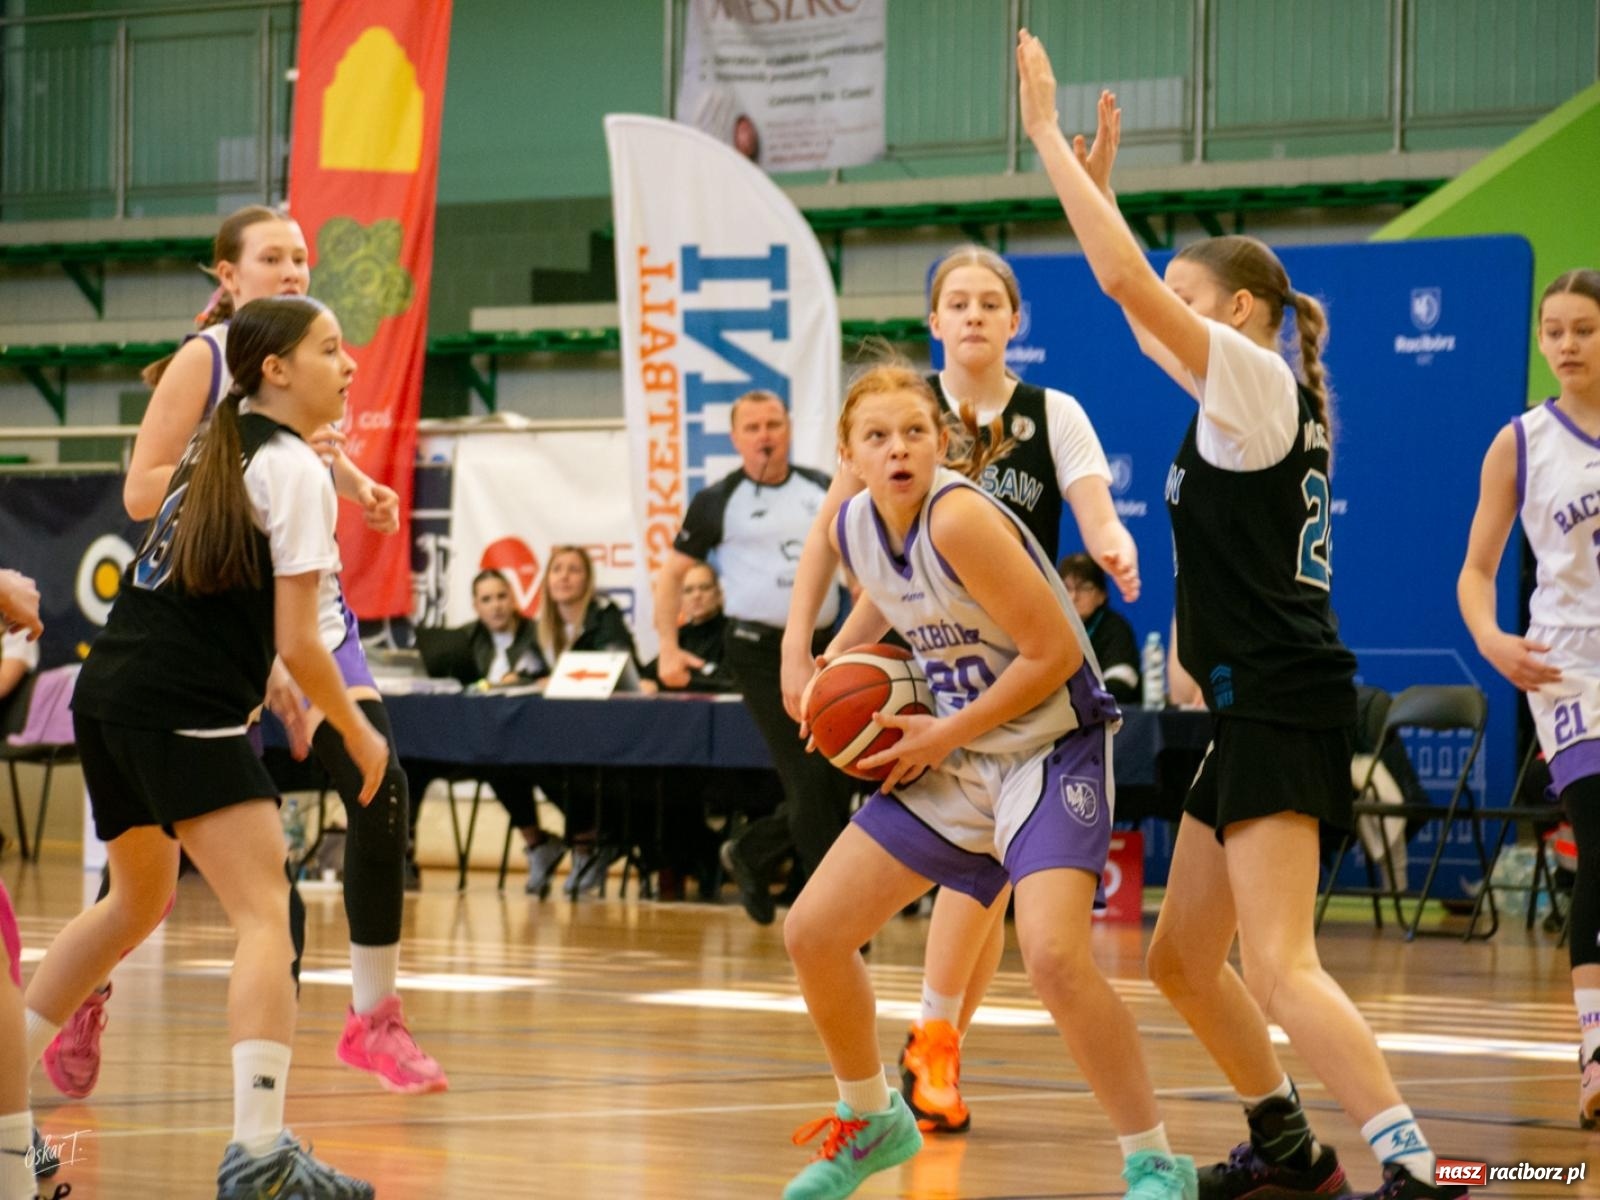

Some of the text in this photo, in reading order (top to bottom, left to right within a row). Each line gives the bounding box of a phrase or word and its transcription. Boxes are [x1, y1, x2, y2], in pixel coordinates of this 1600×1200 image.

[1295, 467, 1333, 592] 2
[1553, 489, 1600, 535] RAC
[1554, 701, 1588, 746] 21
